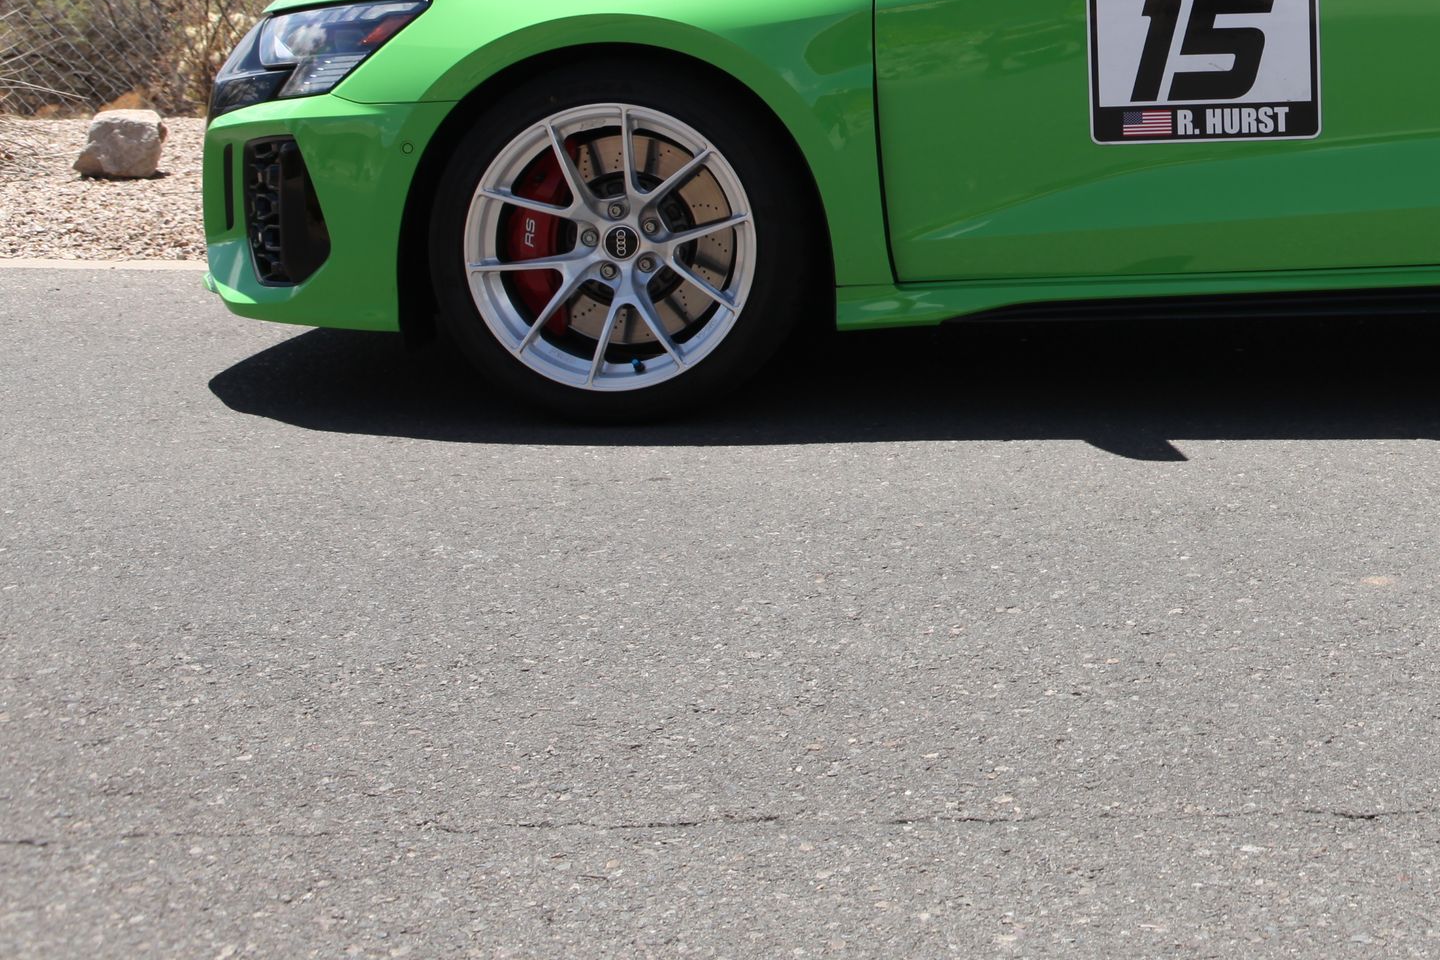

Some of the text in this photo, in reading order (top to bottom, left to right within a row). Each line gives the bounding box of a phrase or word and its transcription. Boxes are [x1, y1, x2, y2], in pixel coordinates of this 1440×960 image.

[1176, 106, 1290, 135] R. HURST
[524, 217, 536, 248] RS
